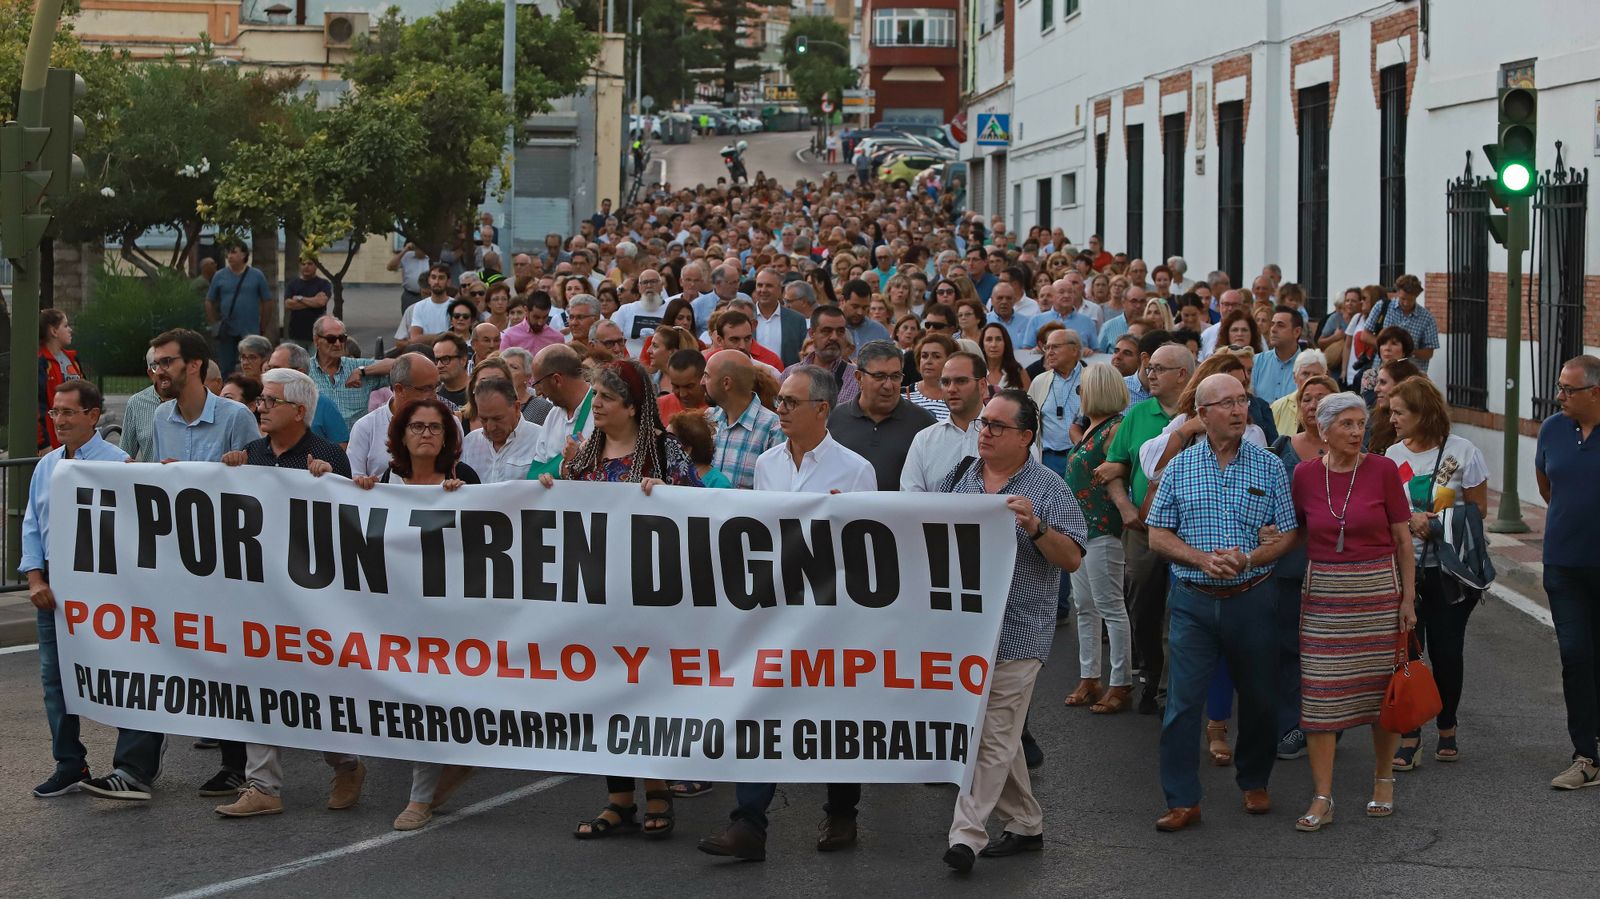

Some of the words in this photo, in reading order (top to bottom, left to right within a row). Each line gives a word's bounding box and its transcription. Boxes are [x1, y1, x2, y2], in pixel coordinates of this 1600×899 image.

[74, 487, 118, 575] ¡¡
[134, 483, 265, 584] POR
[288, 497, 389, 595] UN
[409, 509, 608, 605] TREN
[631, 514, 901, 610] DIGNO
[922, 523, 983, 614] !!
[65, 601, 159, 644] POR
[174, 612, 227, 653] EL
[244, 621, 596, 681] DESARROLLO
[613, 646, 650, 684] Y
[670, 649, 735, 687] EL
[752, 649, 989, 695] EMPLEO
[74, 663, 255, 723] PLATAFORMA
[260, 688, 322, 731] POR
[329, 695, 364, 735] EL
[368, 699, 598, 753] FERROCARRIL
[606, 713, 725, 760] CAMPO
[735, 719, 783, 760] DE
[793, 718, 974, 766] GIBRALTA
